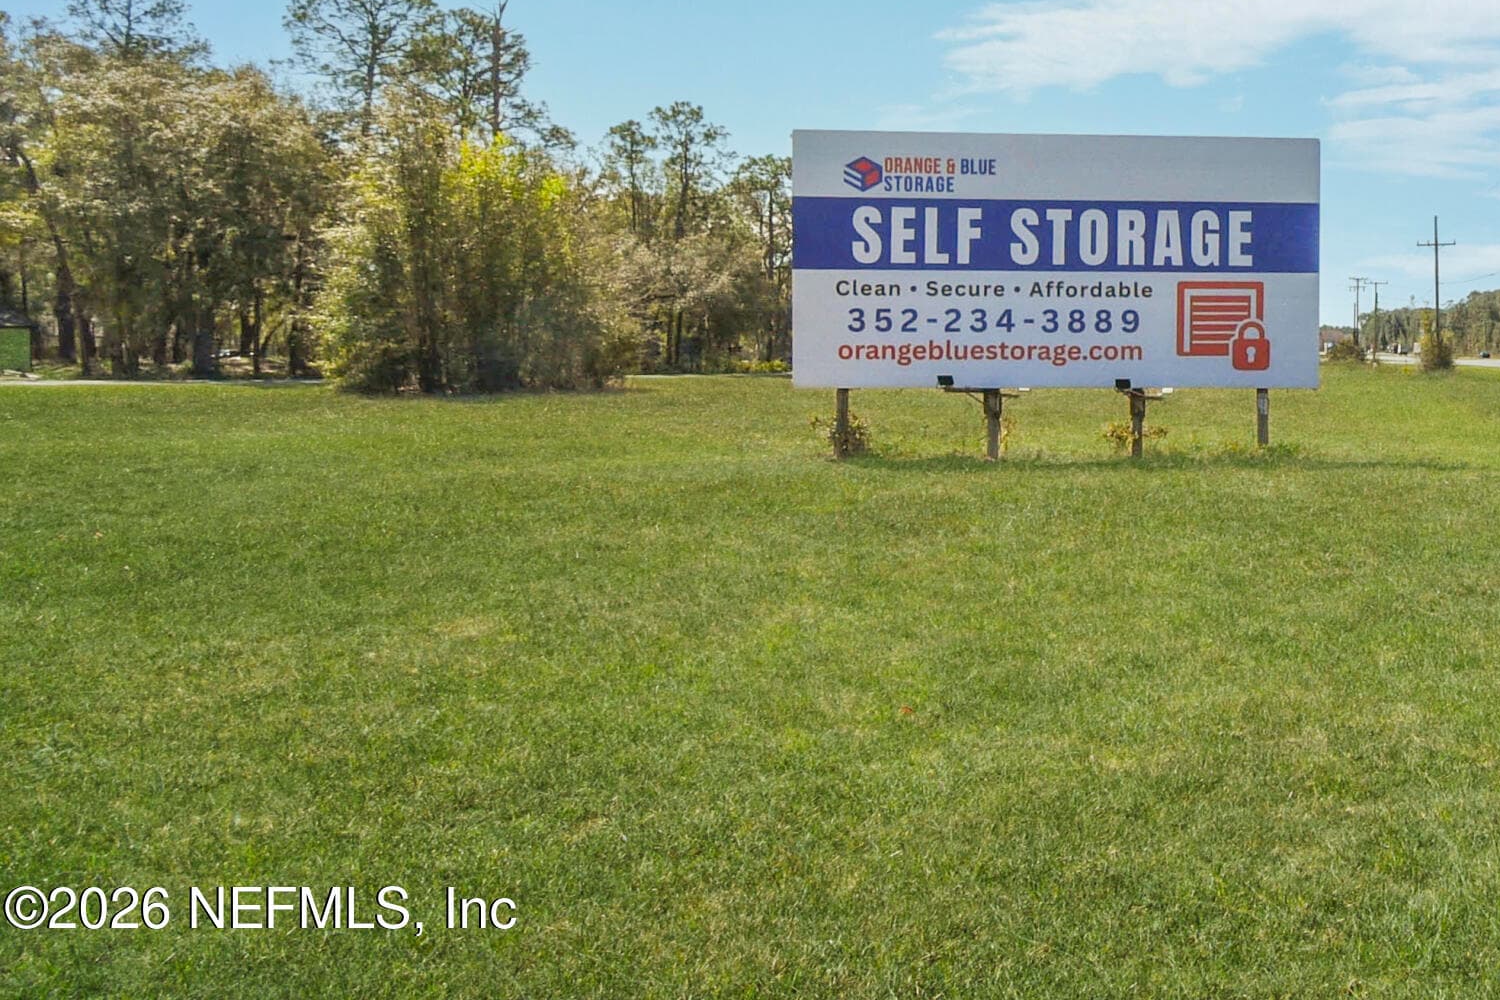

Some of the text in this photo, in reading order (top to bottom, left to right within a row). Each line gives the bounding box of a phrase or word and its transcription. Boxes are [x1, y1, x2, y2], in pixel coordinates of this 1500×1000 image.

[884, 156, 997, 176] ORANGE & BLUE
[883, 174, 955, 193] STORAGE
[851, 205, 1254, 267] SELF STORAGE
[835, 279, 1154, 299] Clean Secure Affordable
[847, 307, 1141, 334] 352-234-3889
[838, 339, 1144, 367] orangebluestorage.com
